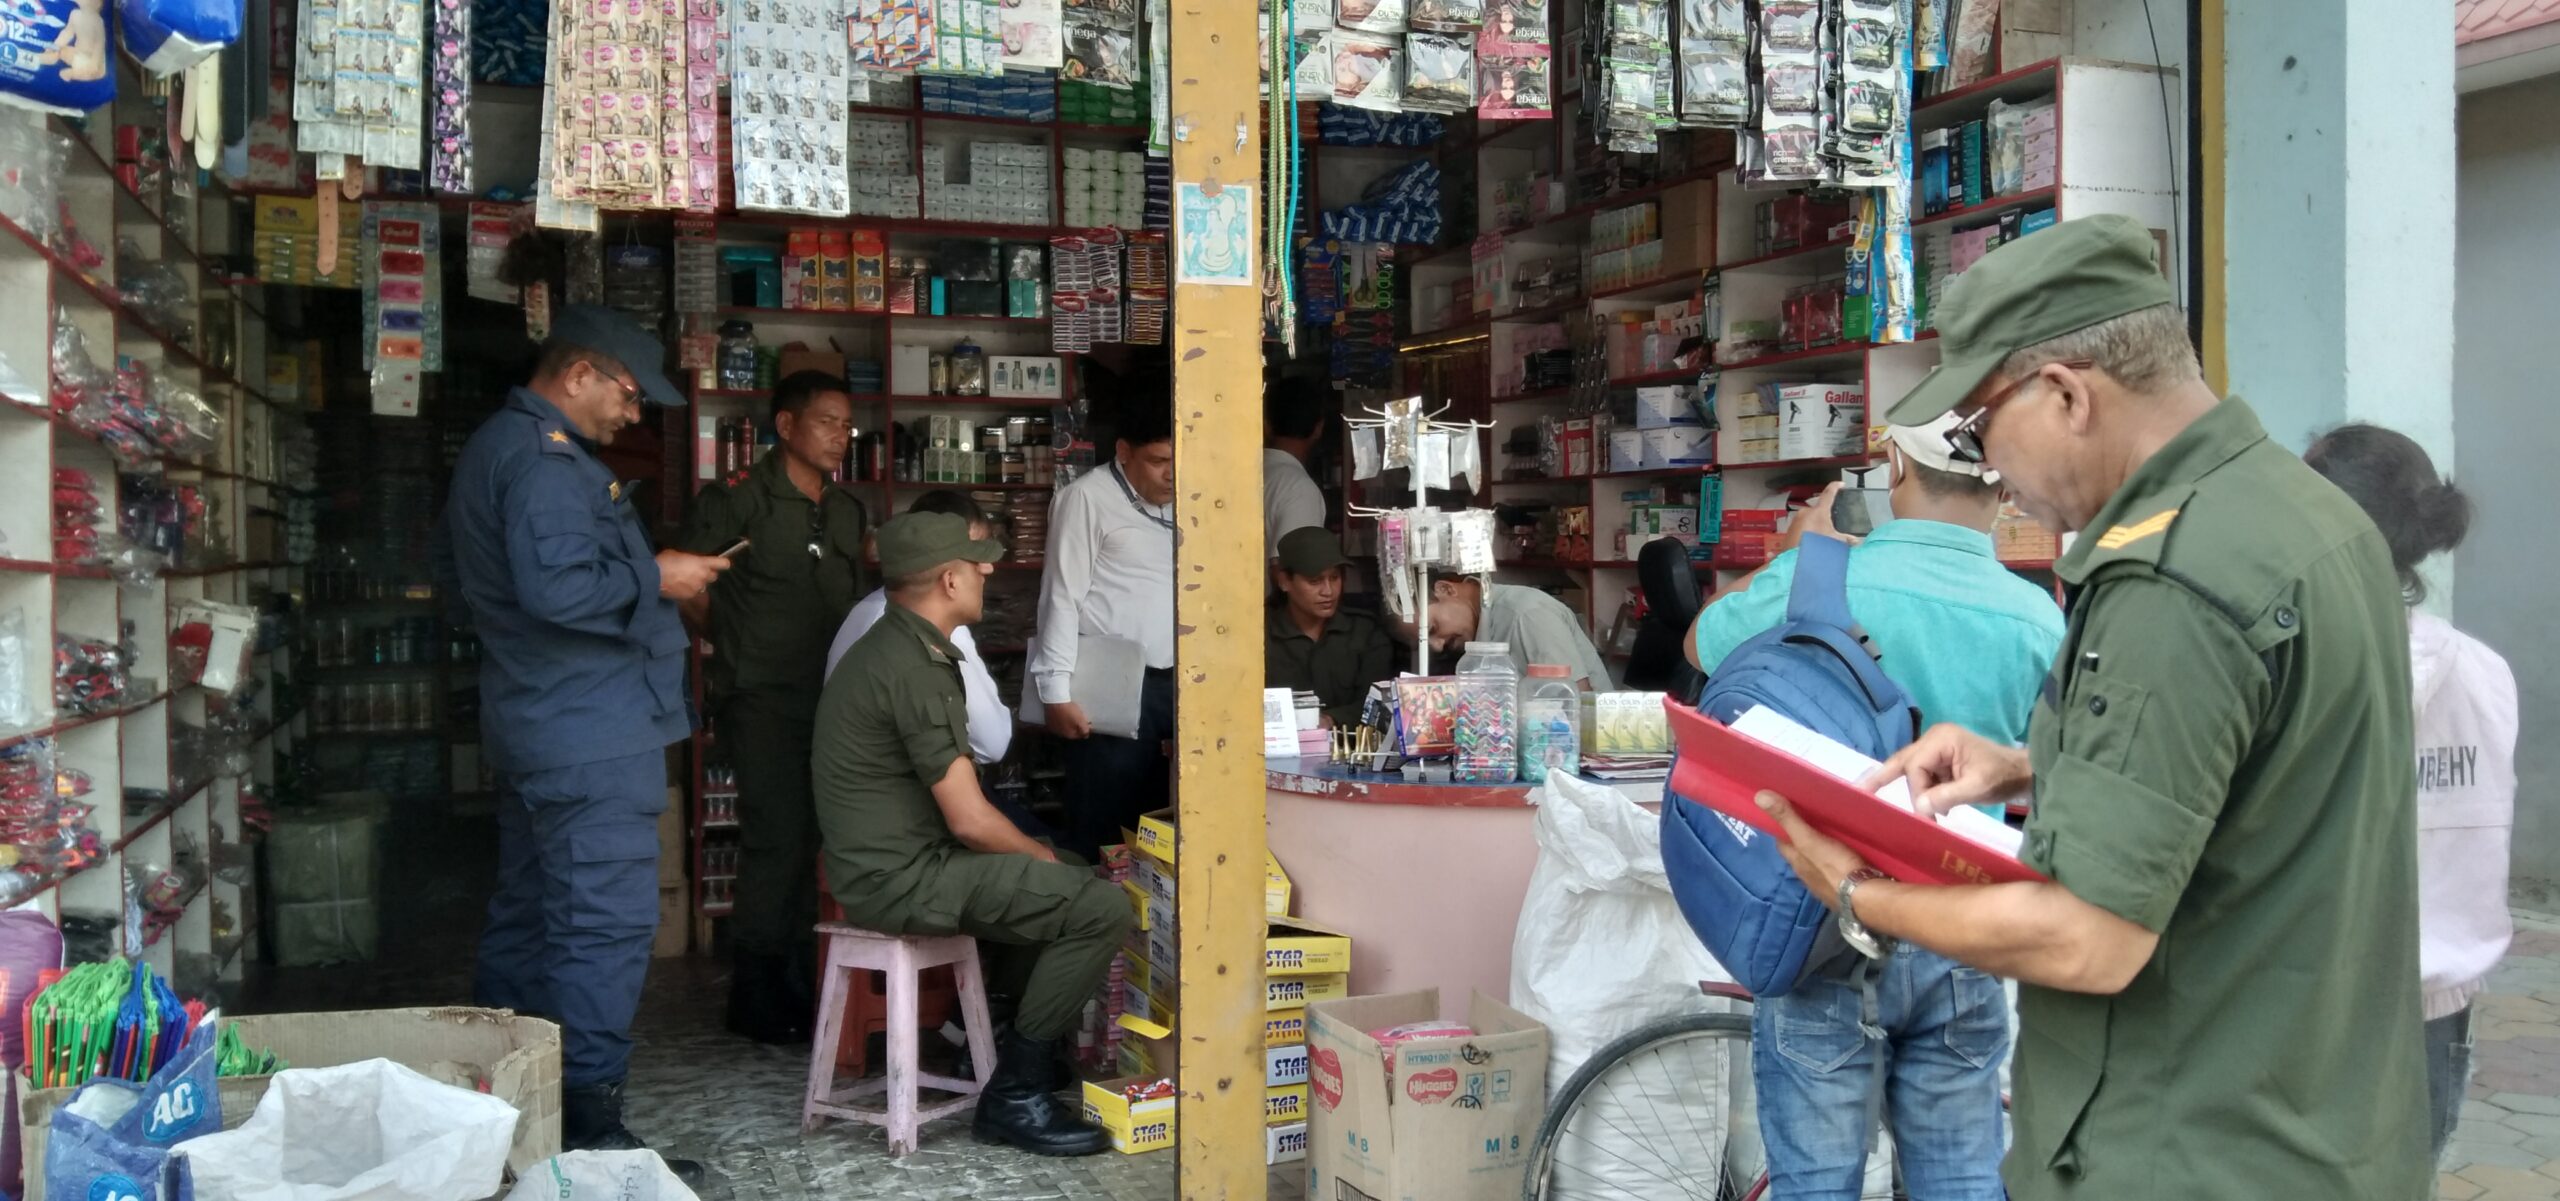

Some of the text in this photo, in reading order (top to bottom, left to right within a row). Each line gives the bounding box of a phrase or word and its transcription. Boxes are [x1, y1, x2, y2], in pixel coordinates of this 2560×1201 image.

[1265, 949, 1303, 969] STAR
[1268, 981, 1305, 1002] STAR
[1266, 1018, 1303, 1039] STAR
[1132, 1122, 1167, 1145] STAR
[1486, 1138, 1500, 1153] M
